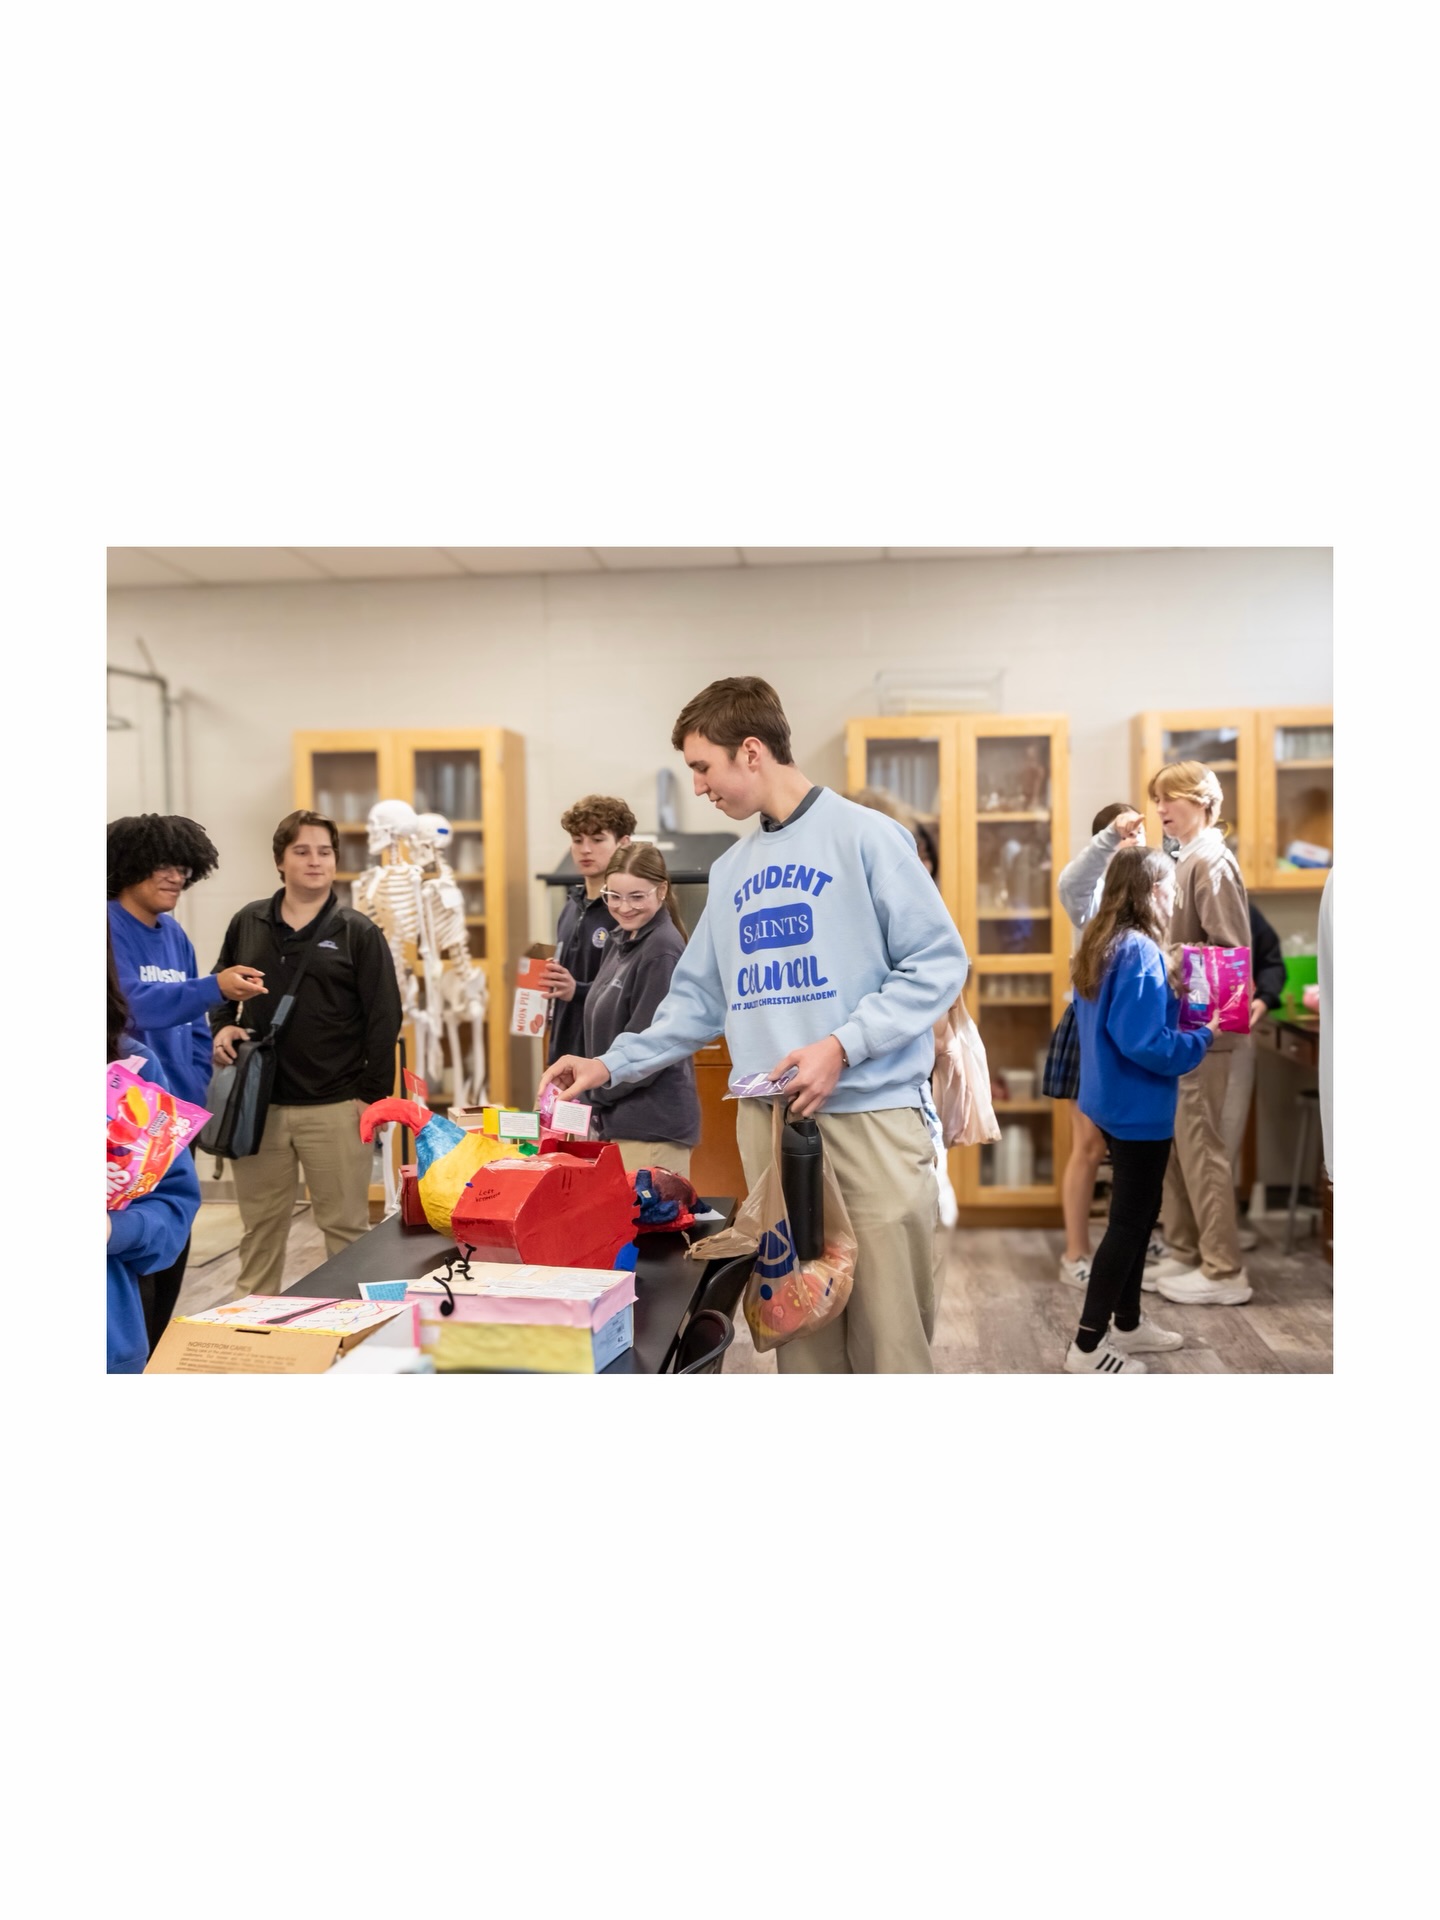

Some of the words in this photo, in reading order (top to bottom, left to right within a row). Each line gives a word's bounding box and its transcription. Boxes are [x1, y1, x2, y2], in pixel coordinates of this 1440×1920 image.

[734, 864, 833, 913] STUDENT
[743, 914, 809, 944] SAINTS
[520, 991, 530, 1006] PIE
[731, 1003, 742, 1011] MT
[759, 995, 801, 1007] CHRISTIAN
[801, 989, 837, 1002] ACADEMY
[516, 1007, 528, 1032] MOON
